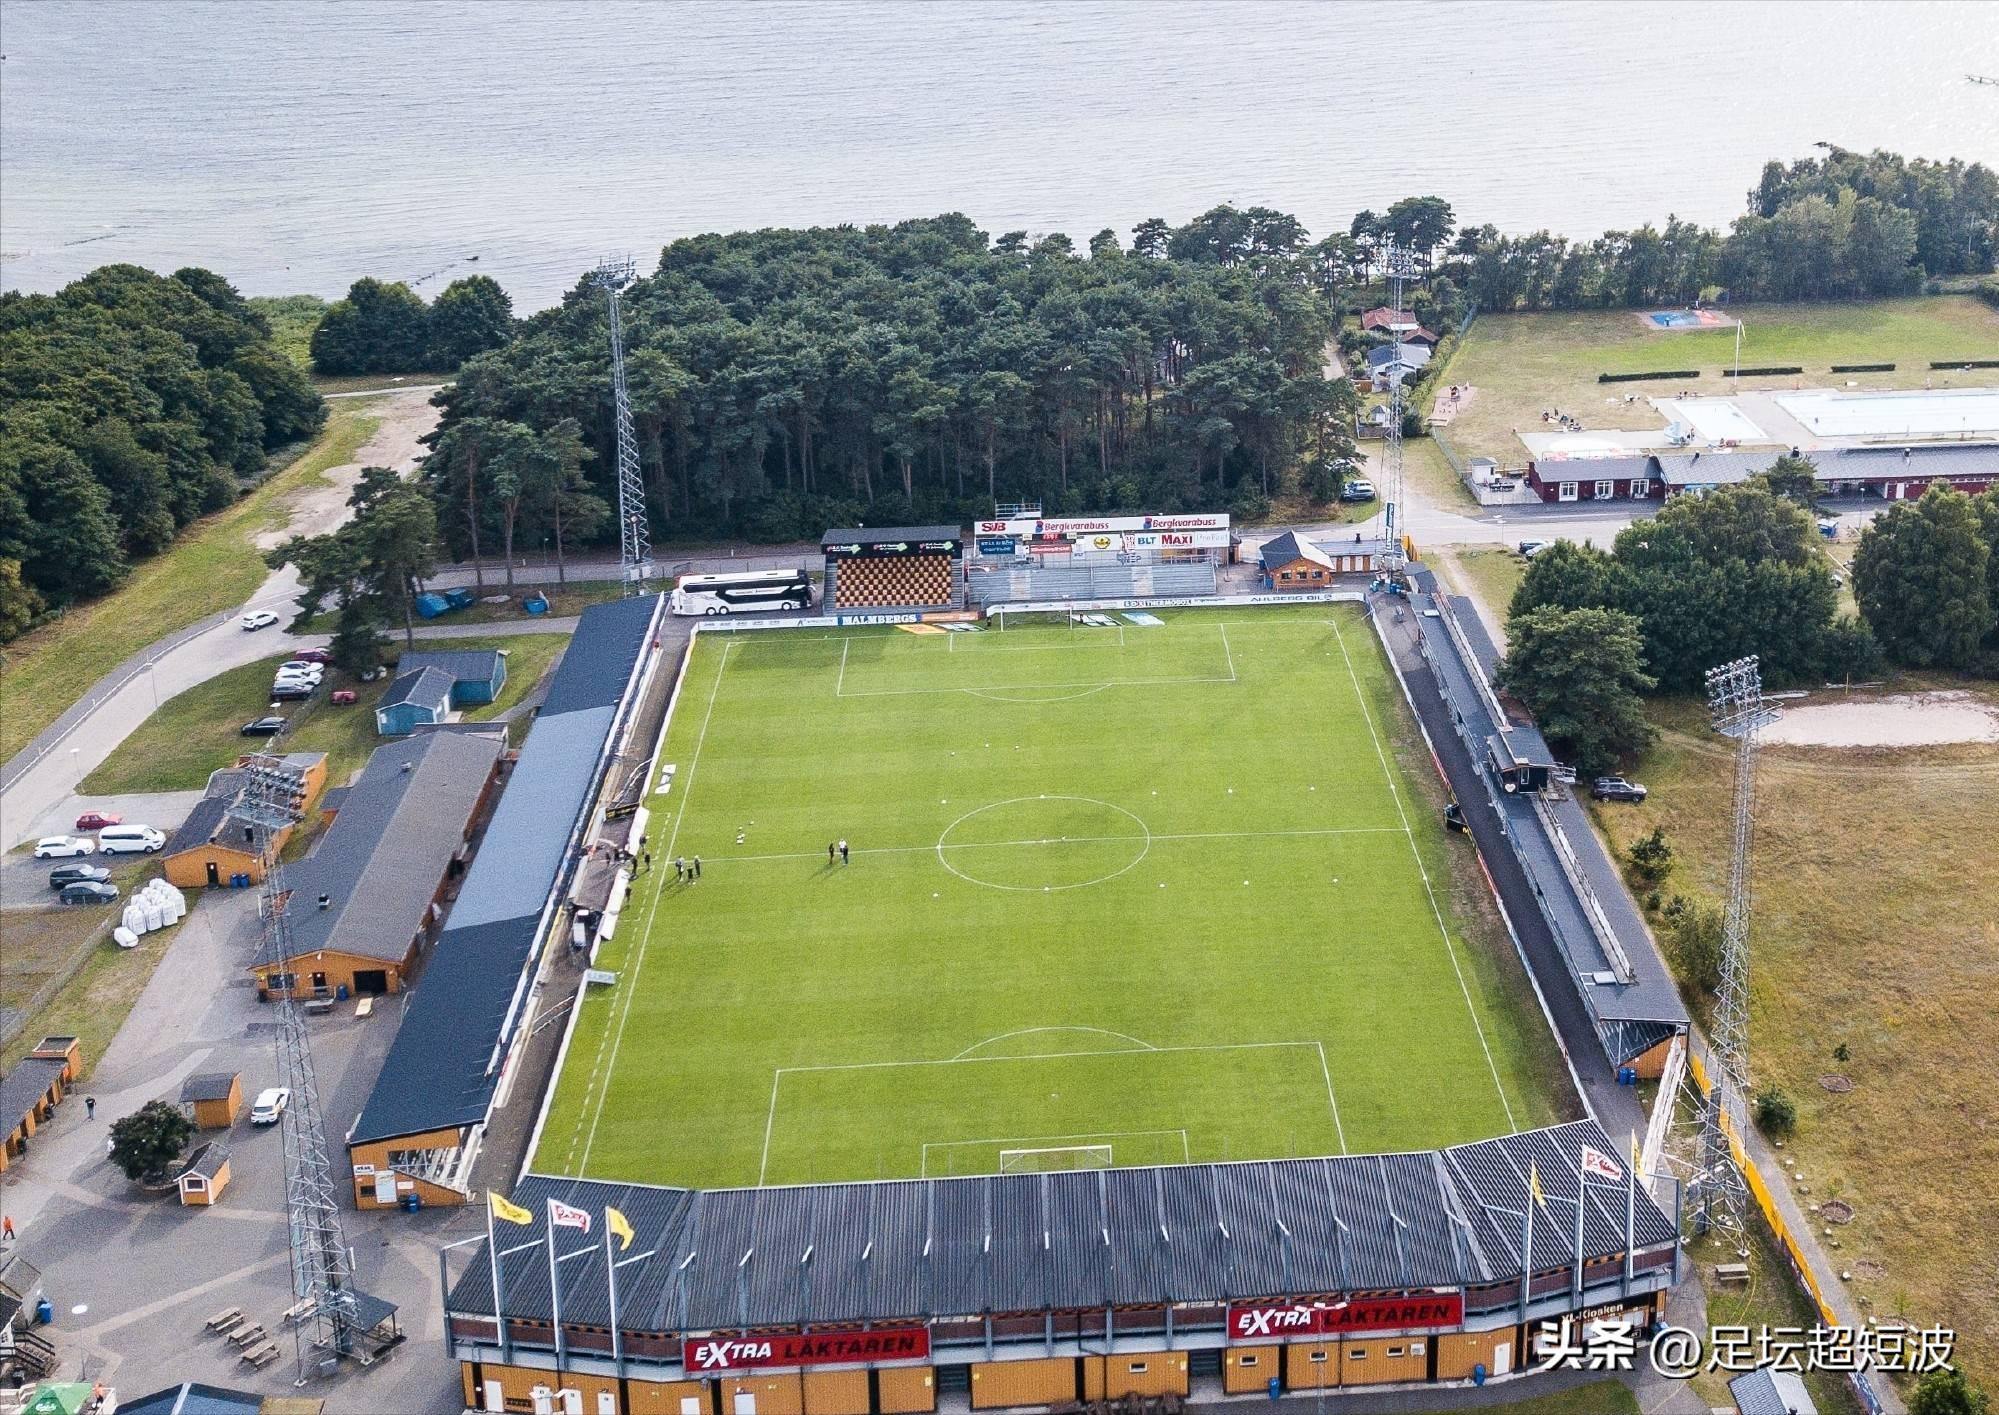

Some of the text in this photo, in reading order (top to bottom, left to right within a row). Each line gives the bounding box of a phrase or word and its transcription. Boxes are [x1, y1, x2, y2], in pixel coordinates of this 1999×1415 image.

[1044, 521, 1109, 533] Bergkvarabuss
[1152, 518, 1216, 529] Bergkvarabuss
[1137, 536, 1157, 545] BLT
[1161, 534, 1193, 545] MAXI
[842, 614, 917, 625] MALMBERGS
[1238, 1308, 1312, 1336] EXTRA
[695, 1336, 916, 1368] EXTRA LÄKTAREN
